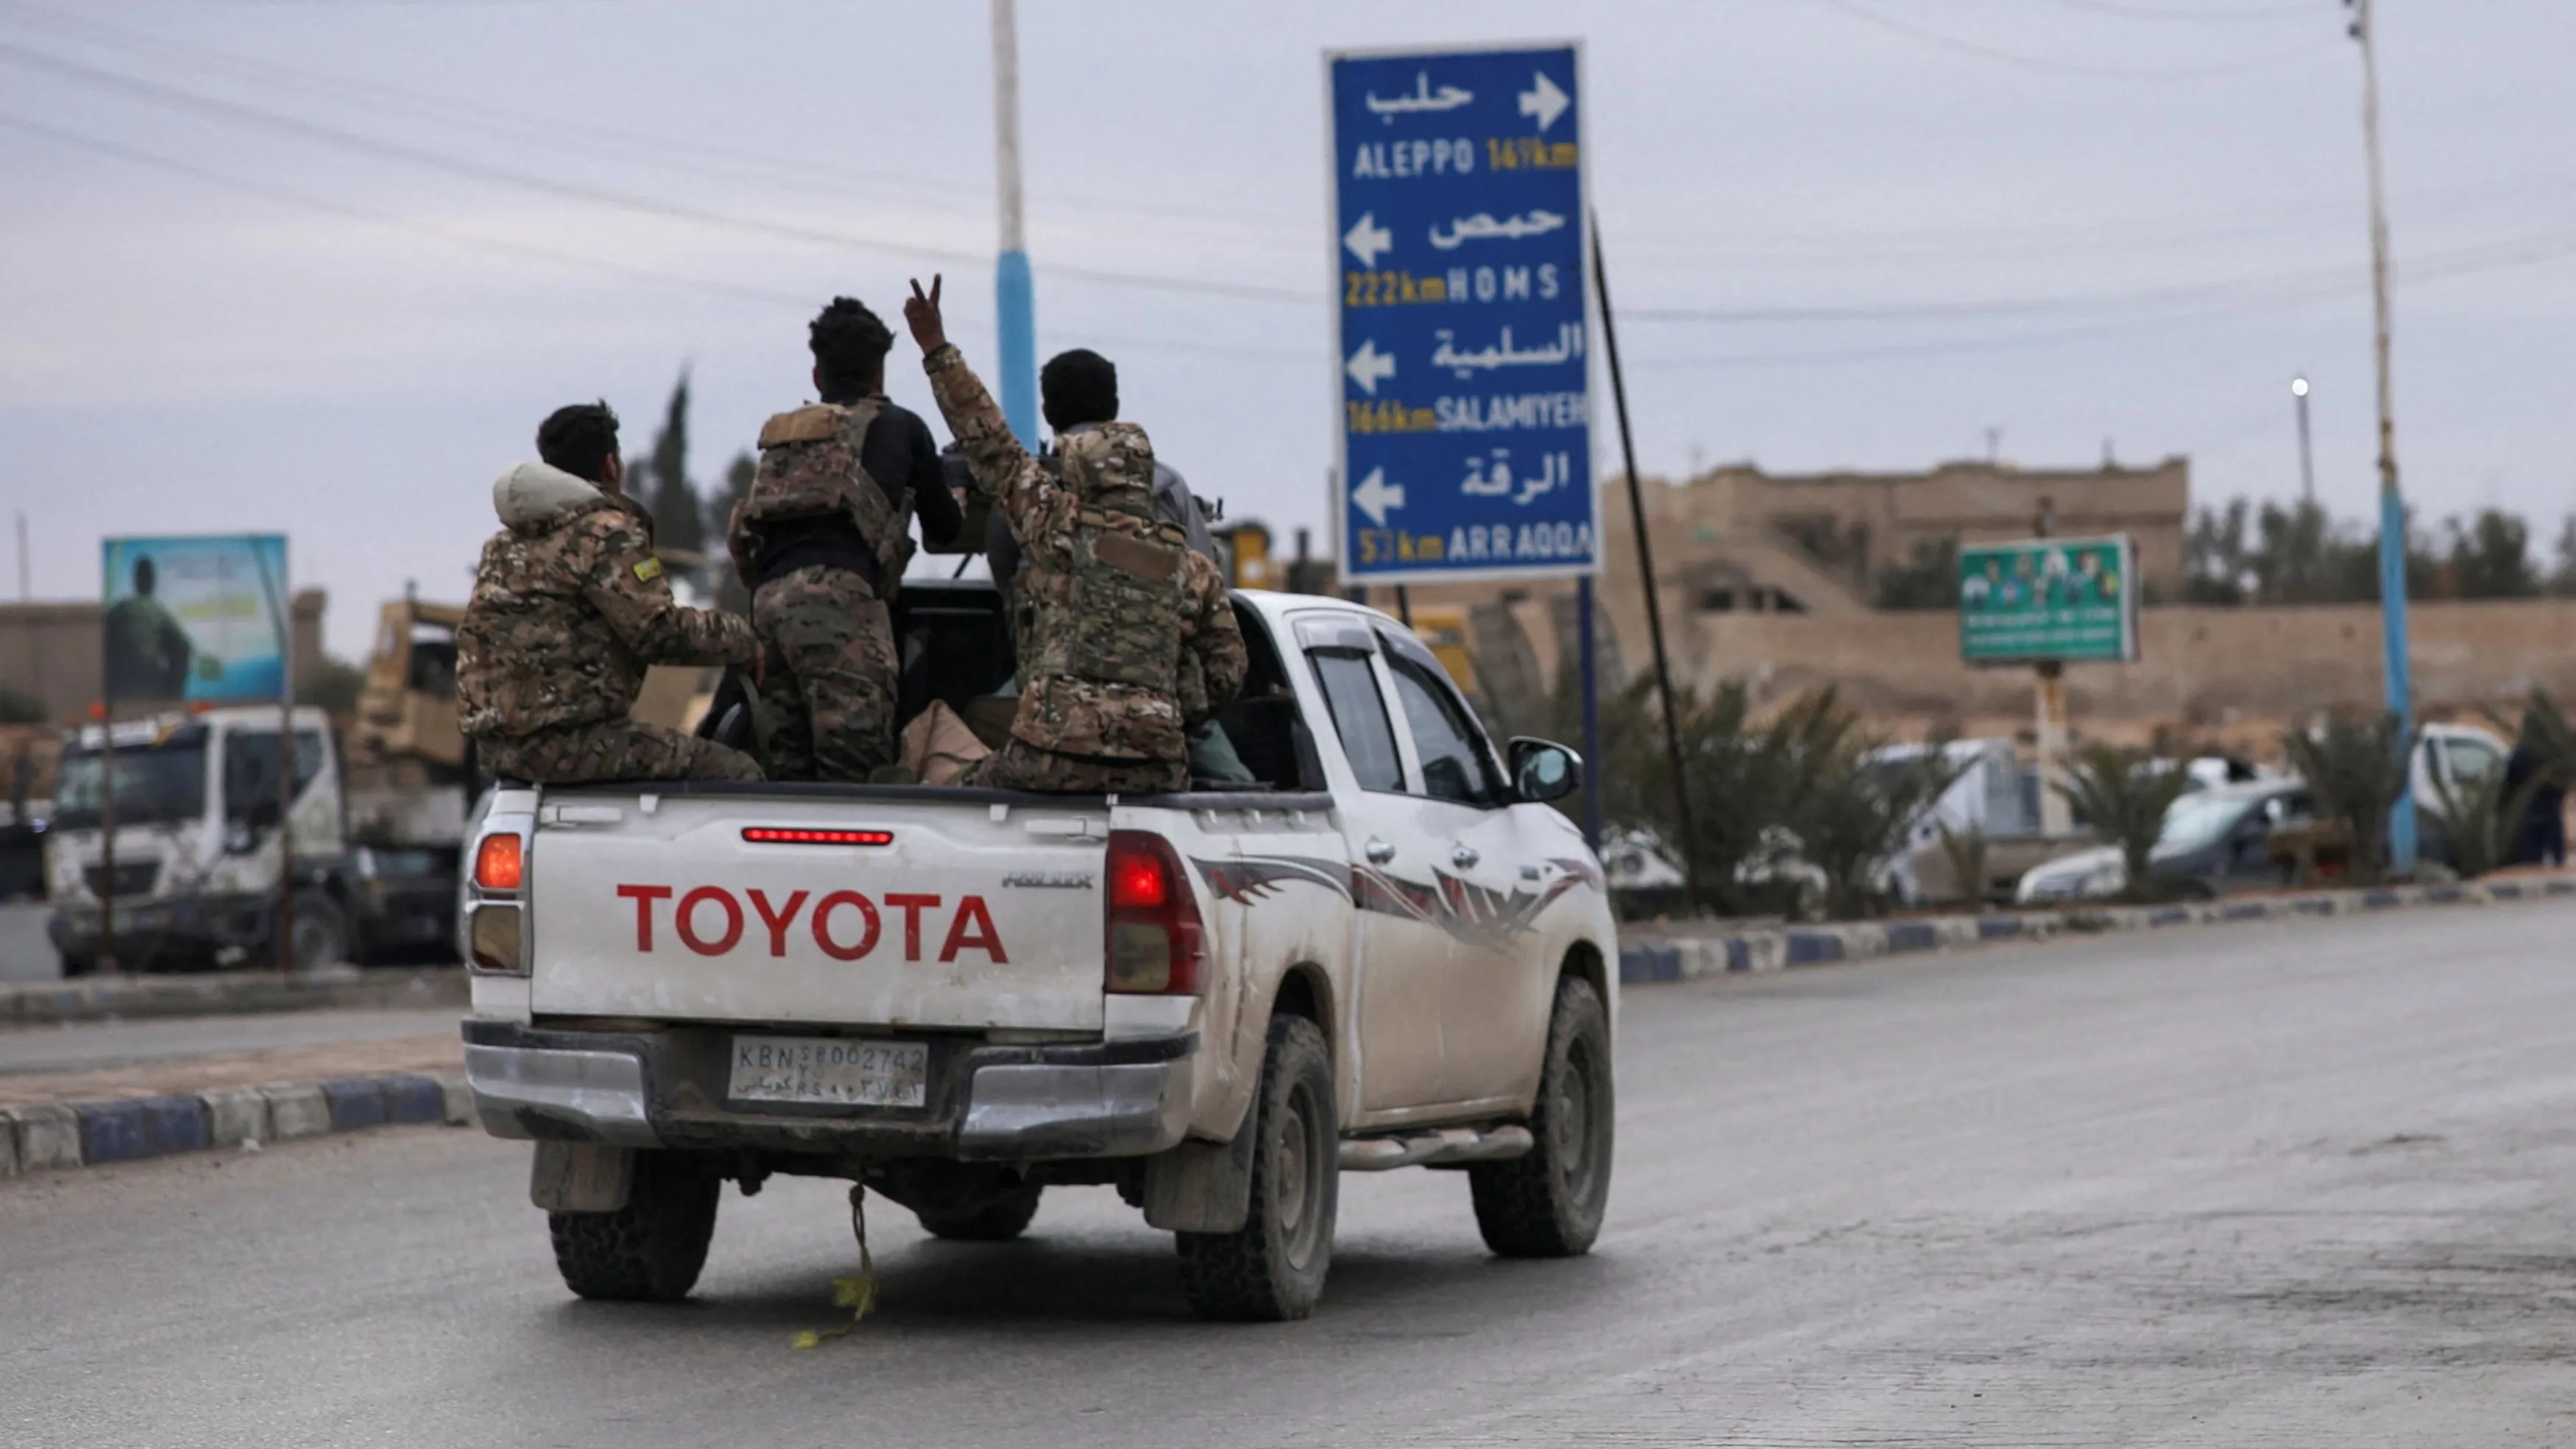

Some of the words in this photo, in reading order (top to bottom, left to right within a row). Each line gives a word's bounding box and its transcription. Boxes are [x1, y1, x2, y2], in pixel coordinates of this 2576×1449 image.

[1365, 71, 1474, 126] حلب
[1353, 138, 1475, 179] ALEPPO
[1429, 209, 1567, 250] حمص
[1447, 263, 1560, 304] HOMS
[1431, 322, 1585, 380] السلمية
[1460, 448, 1570, 507] الرقة
[617, 885, 1009, 964] TOYOTA
